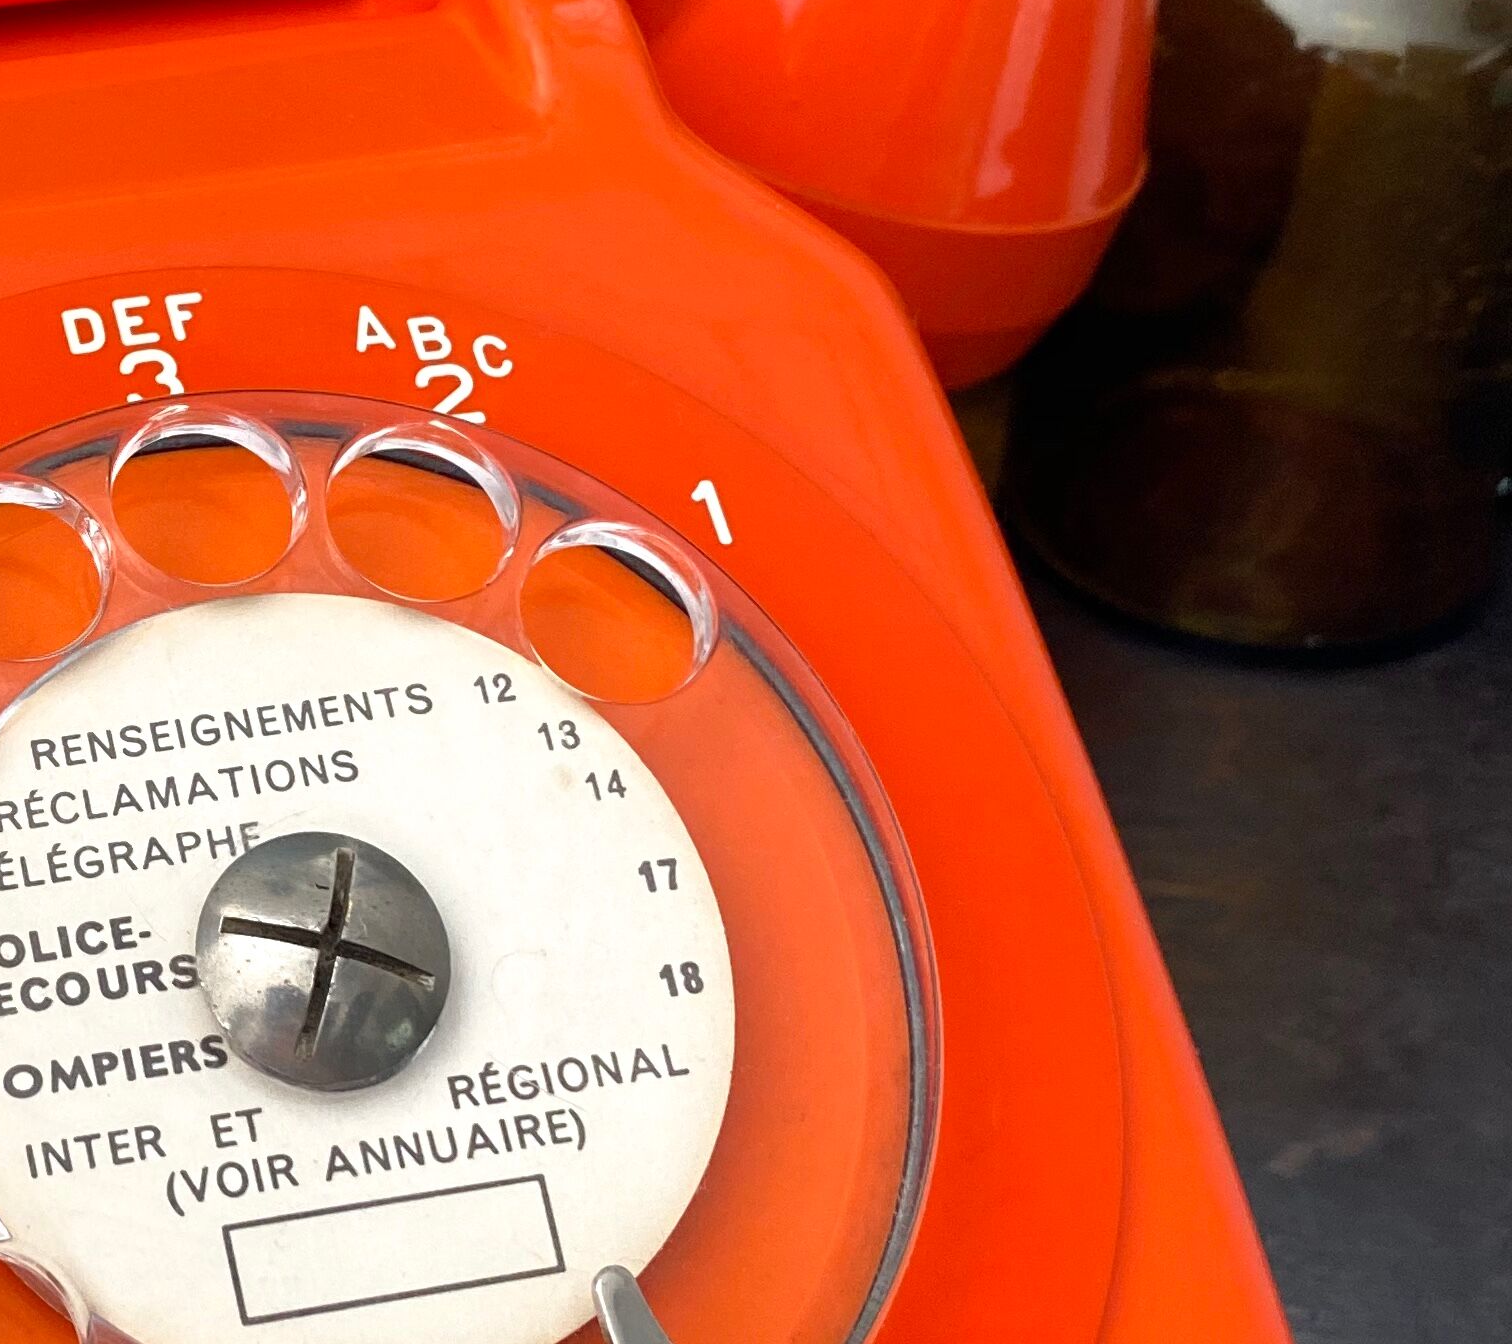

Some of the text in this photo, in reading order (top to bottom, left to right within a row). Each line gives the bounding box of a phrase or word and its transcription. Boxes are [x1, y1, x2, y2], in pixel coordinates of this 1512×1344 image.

[61, 292, 202, 355] DEF
[356, 305, 513, 378] ABC
[120, 349, 185, 403] 3
[415, 363, 486, 424] 2
[691, 479, 733, 545] 1
[30, 673, 517, 771] RENSEIGNEMENTS 12
[538, 720, 580, 751] 13
[585, 769, 627, 801] 14
[638, 858, 678, 893] 17
[659, 961, 704, 997] 18
[25, 1044, 690, 1179] INTER ET RÉGIONAL
[166, 1108, 587, 1217] (VOIR ANNUAIRE)
